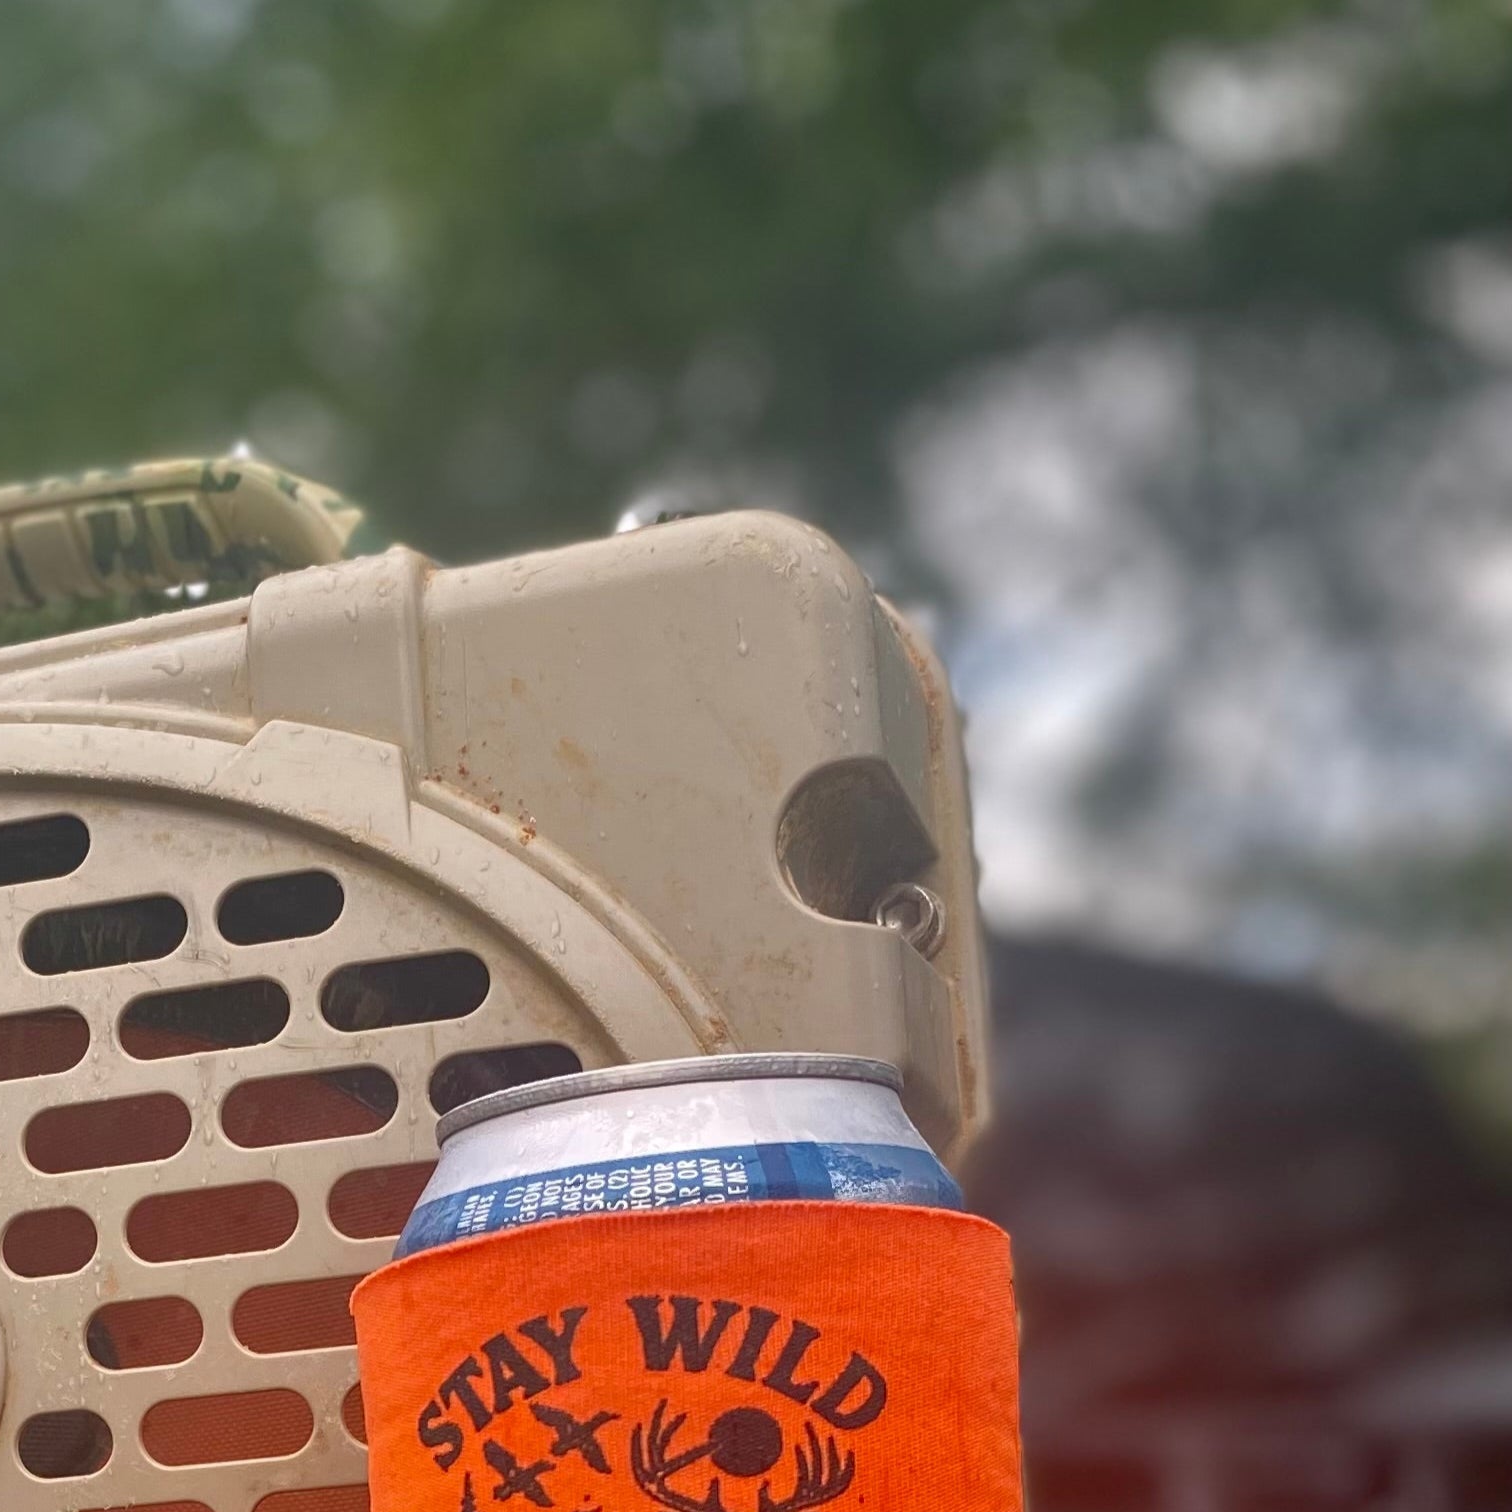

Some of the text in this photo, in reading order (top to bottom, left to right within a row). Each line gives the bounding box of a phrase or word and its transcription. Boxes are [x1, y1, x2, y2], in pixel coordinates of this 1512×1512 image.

[607, 1169, 630, 1190] (2)
[653, 1161, 677, 1207] YOUR
[676, 1159, 700, 1180] OR
[699, 1158, 725, 1188] MAY
[540, 1179, 564, 1208] NOT
[584, 1172, 606, 1212] SE OF
[630, 1164, 653, 1211] HOLIC
[417, 1295, 888, 1472] STAY WILD
